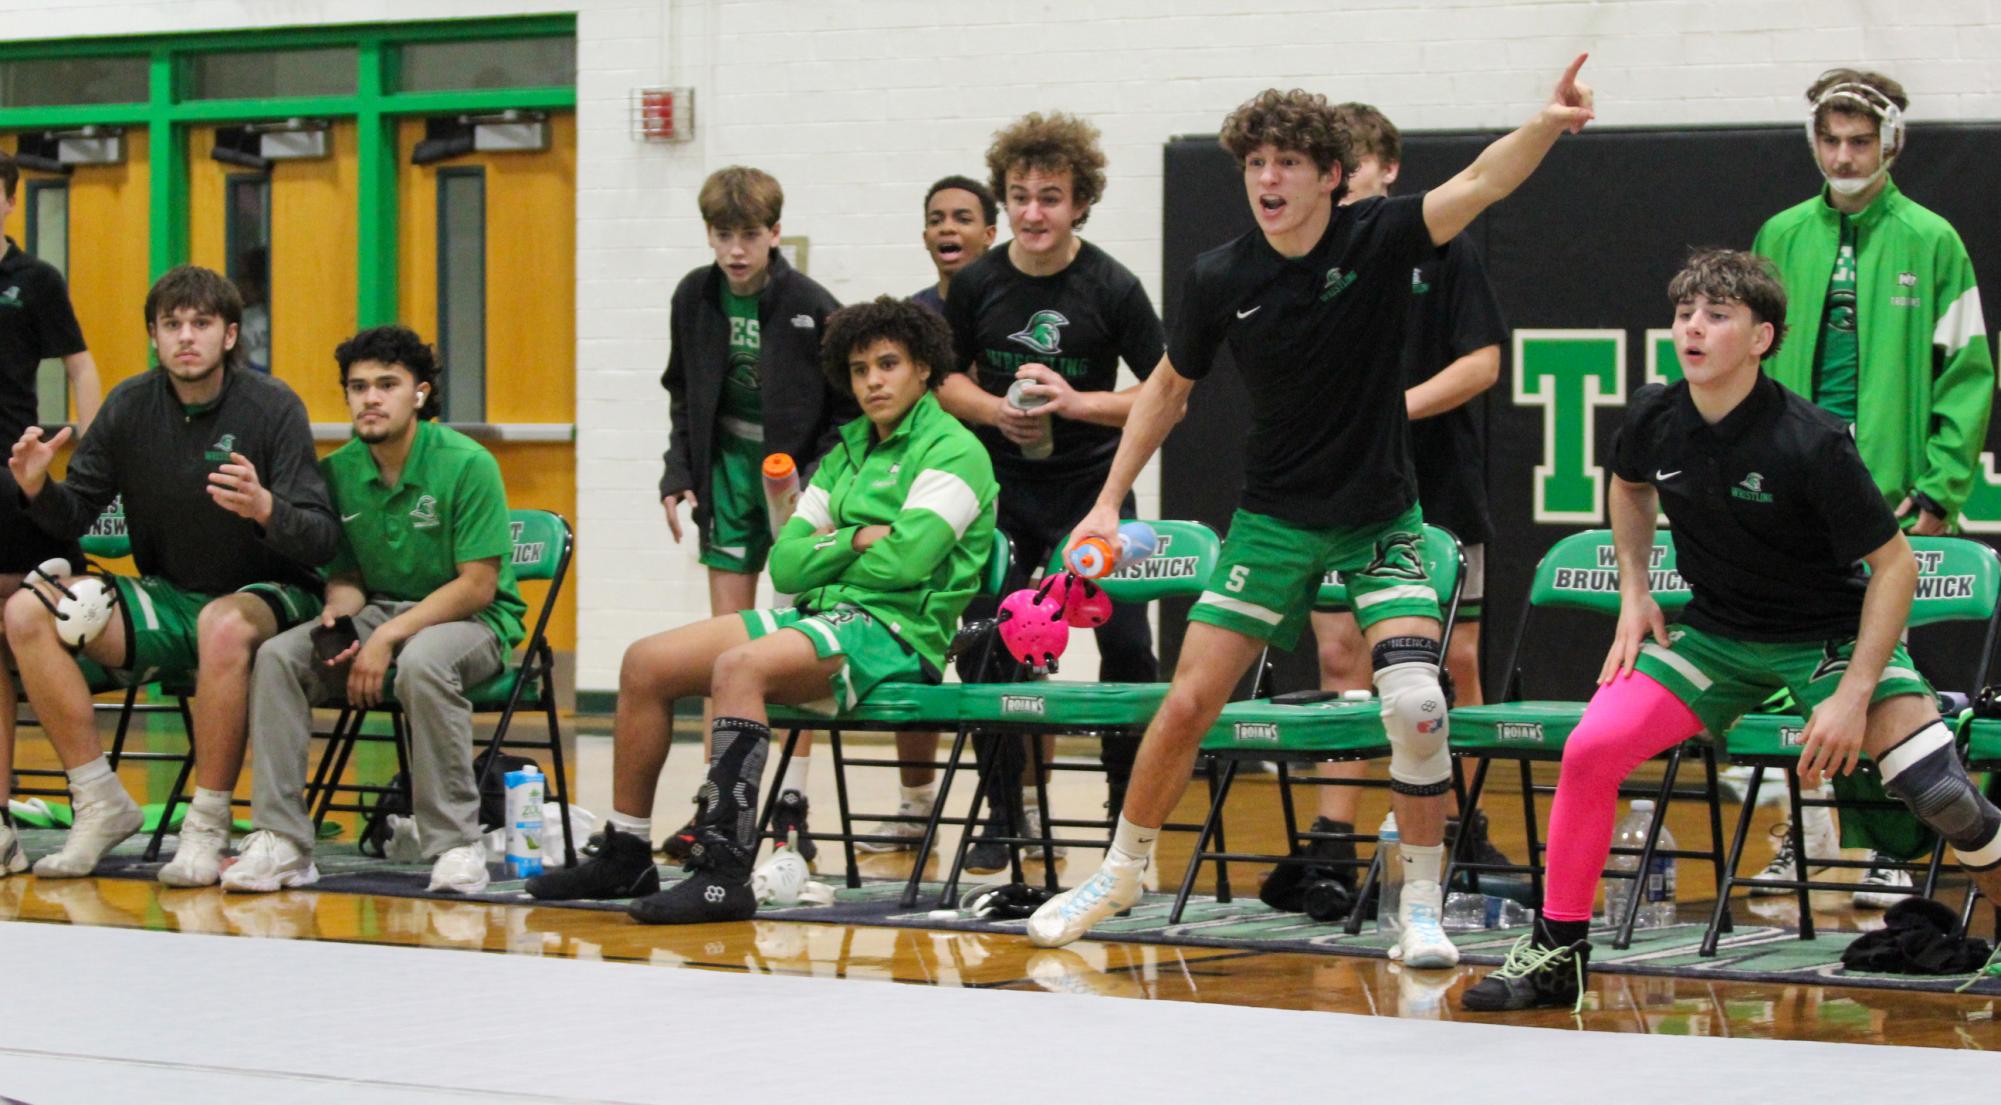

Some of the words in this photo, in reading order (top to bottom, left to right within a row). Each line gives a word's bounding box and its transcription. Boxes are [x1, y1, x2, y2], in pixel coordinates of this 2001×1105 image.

[728, 316, 761, 349] ES
[511, 542, 545, 564] ICK
[1597, 545, 1668, 567] WT
[1913, 574, 1977, 600] WICK
[1001, 695, 1045, 714] TROJANS
[1234, 722, 1279, 742] TROJANS
[1496, 722, 1543, 742] TROJANS
